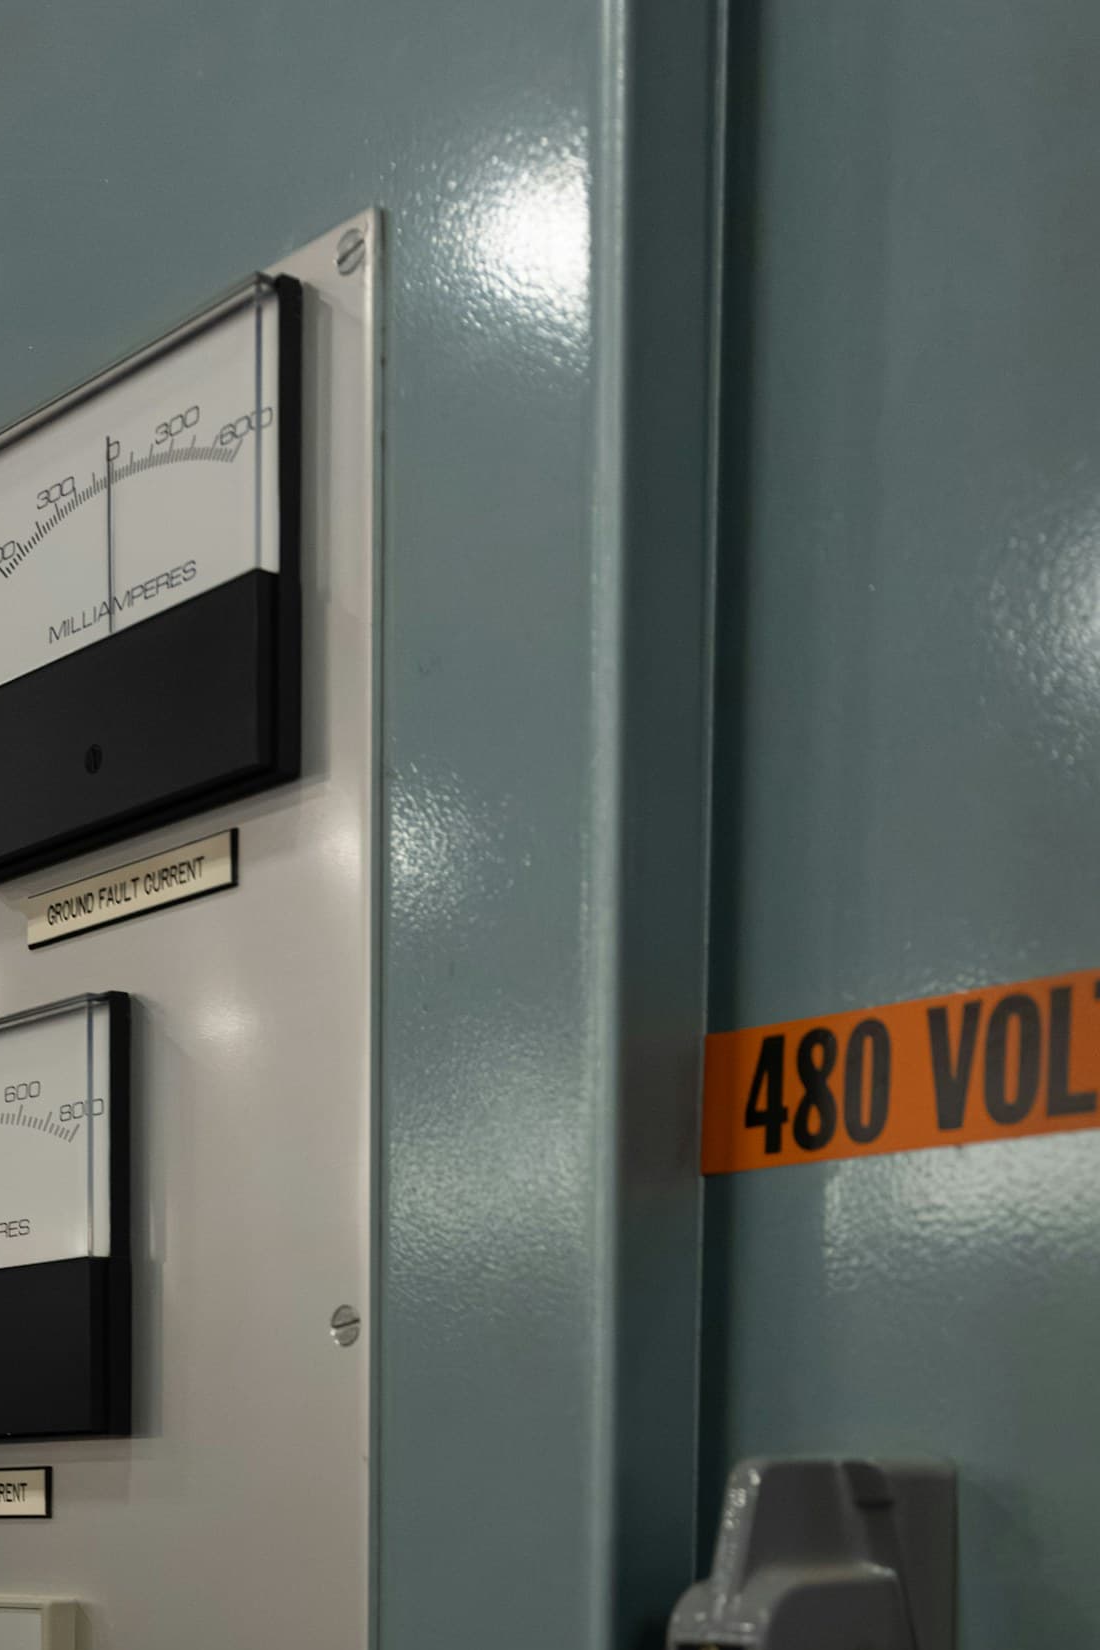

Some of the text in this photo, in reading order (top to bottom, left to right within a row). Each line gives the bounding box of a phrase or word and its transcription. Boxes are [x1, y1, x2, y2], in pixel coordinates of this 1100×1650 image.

[155, 405, 200, 445] 300
[219, 406, 273, 446] 600
[36, 476, 75, 510] 300
[49, 559, 197, 644] MILLIAMPERES
[47, 856, 205, 926] GROUND FAULT CURRENT
[744, 983, 1100, 1154] 480 VOL
[4, 1080, 41, 1103] 600
[59, 1098, 104, 1123] 800
